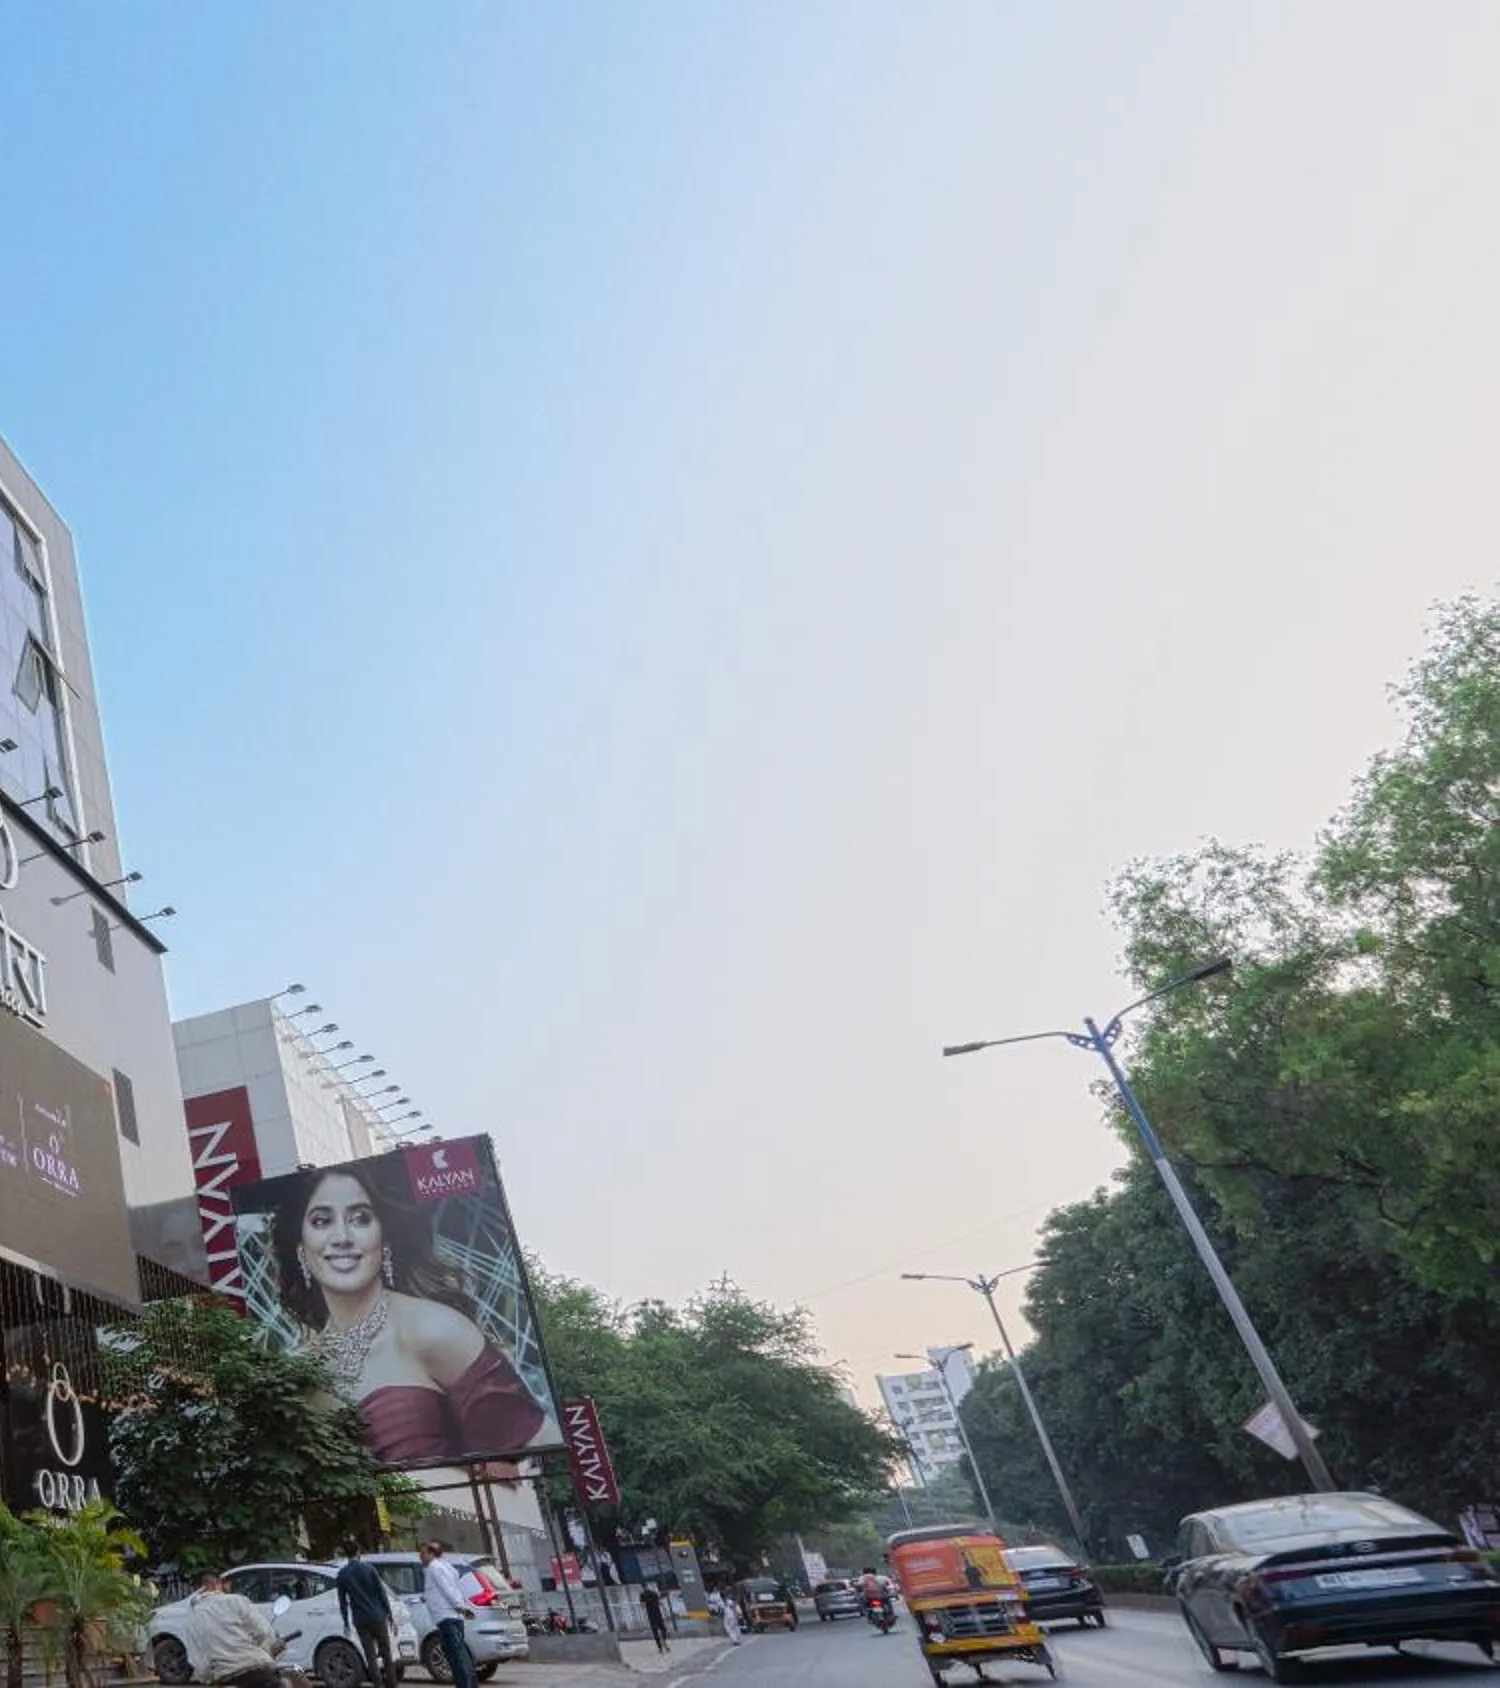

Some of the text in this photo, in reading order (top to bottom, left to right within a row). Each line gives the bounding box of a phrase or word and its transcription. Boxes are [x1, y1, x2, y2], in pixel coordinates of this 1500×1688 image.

[33, 1147, 79, 1190] ORRA
[417, 1168, 475, 1191] KALYAN
[189, 1120, 248, 1298] ALYAN
[565, 1405, 609, 1500] KALYAN
